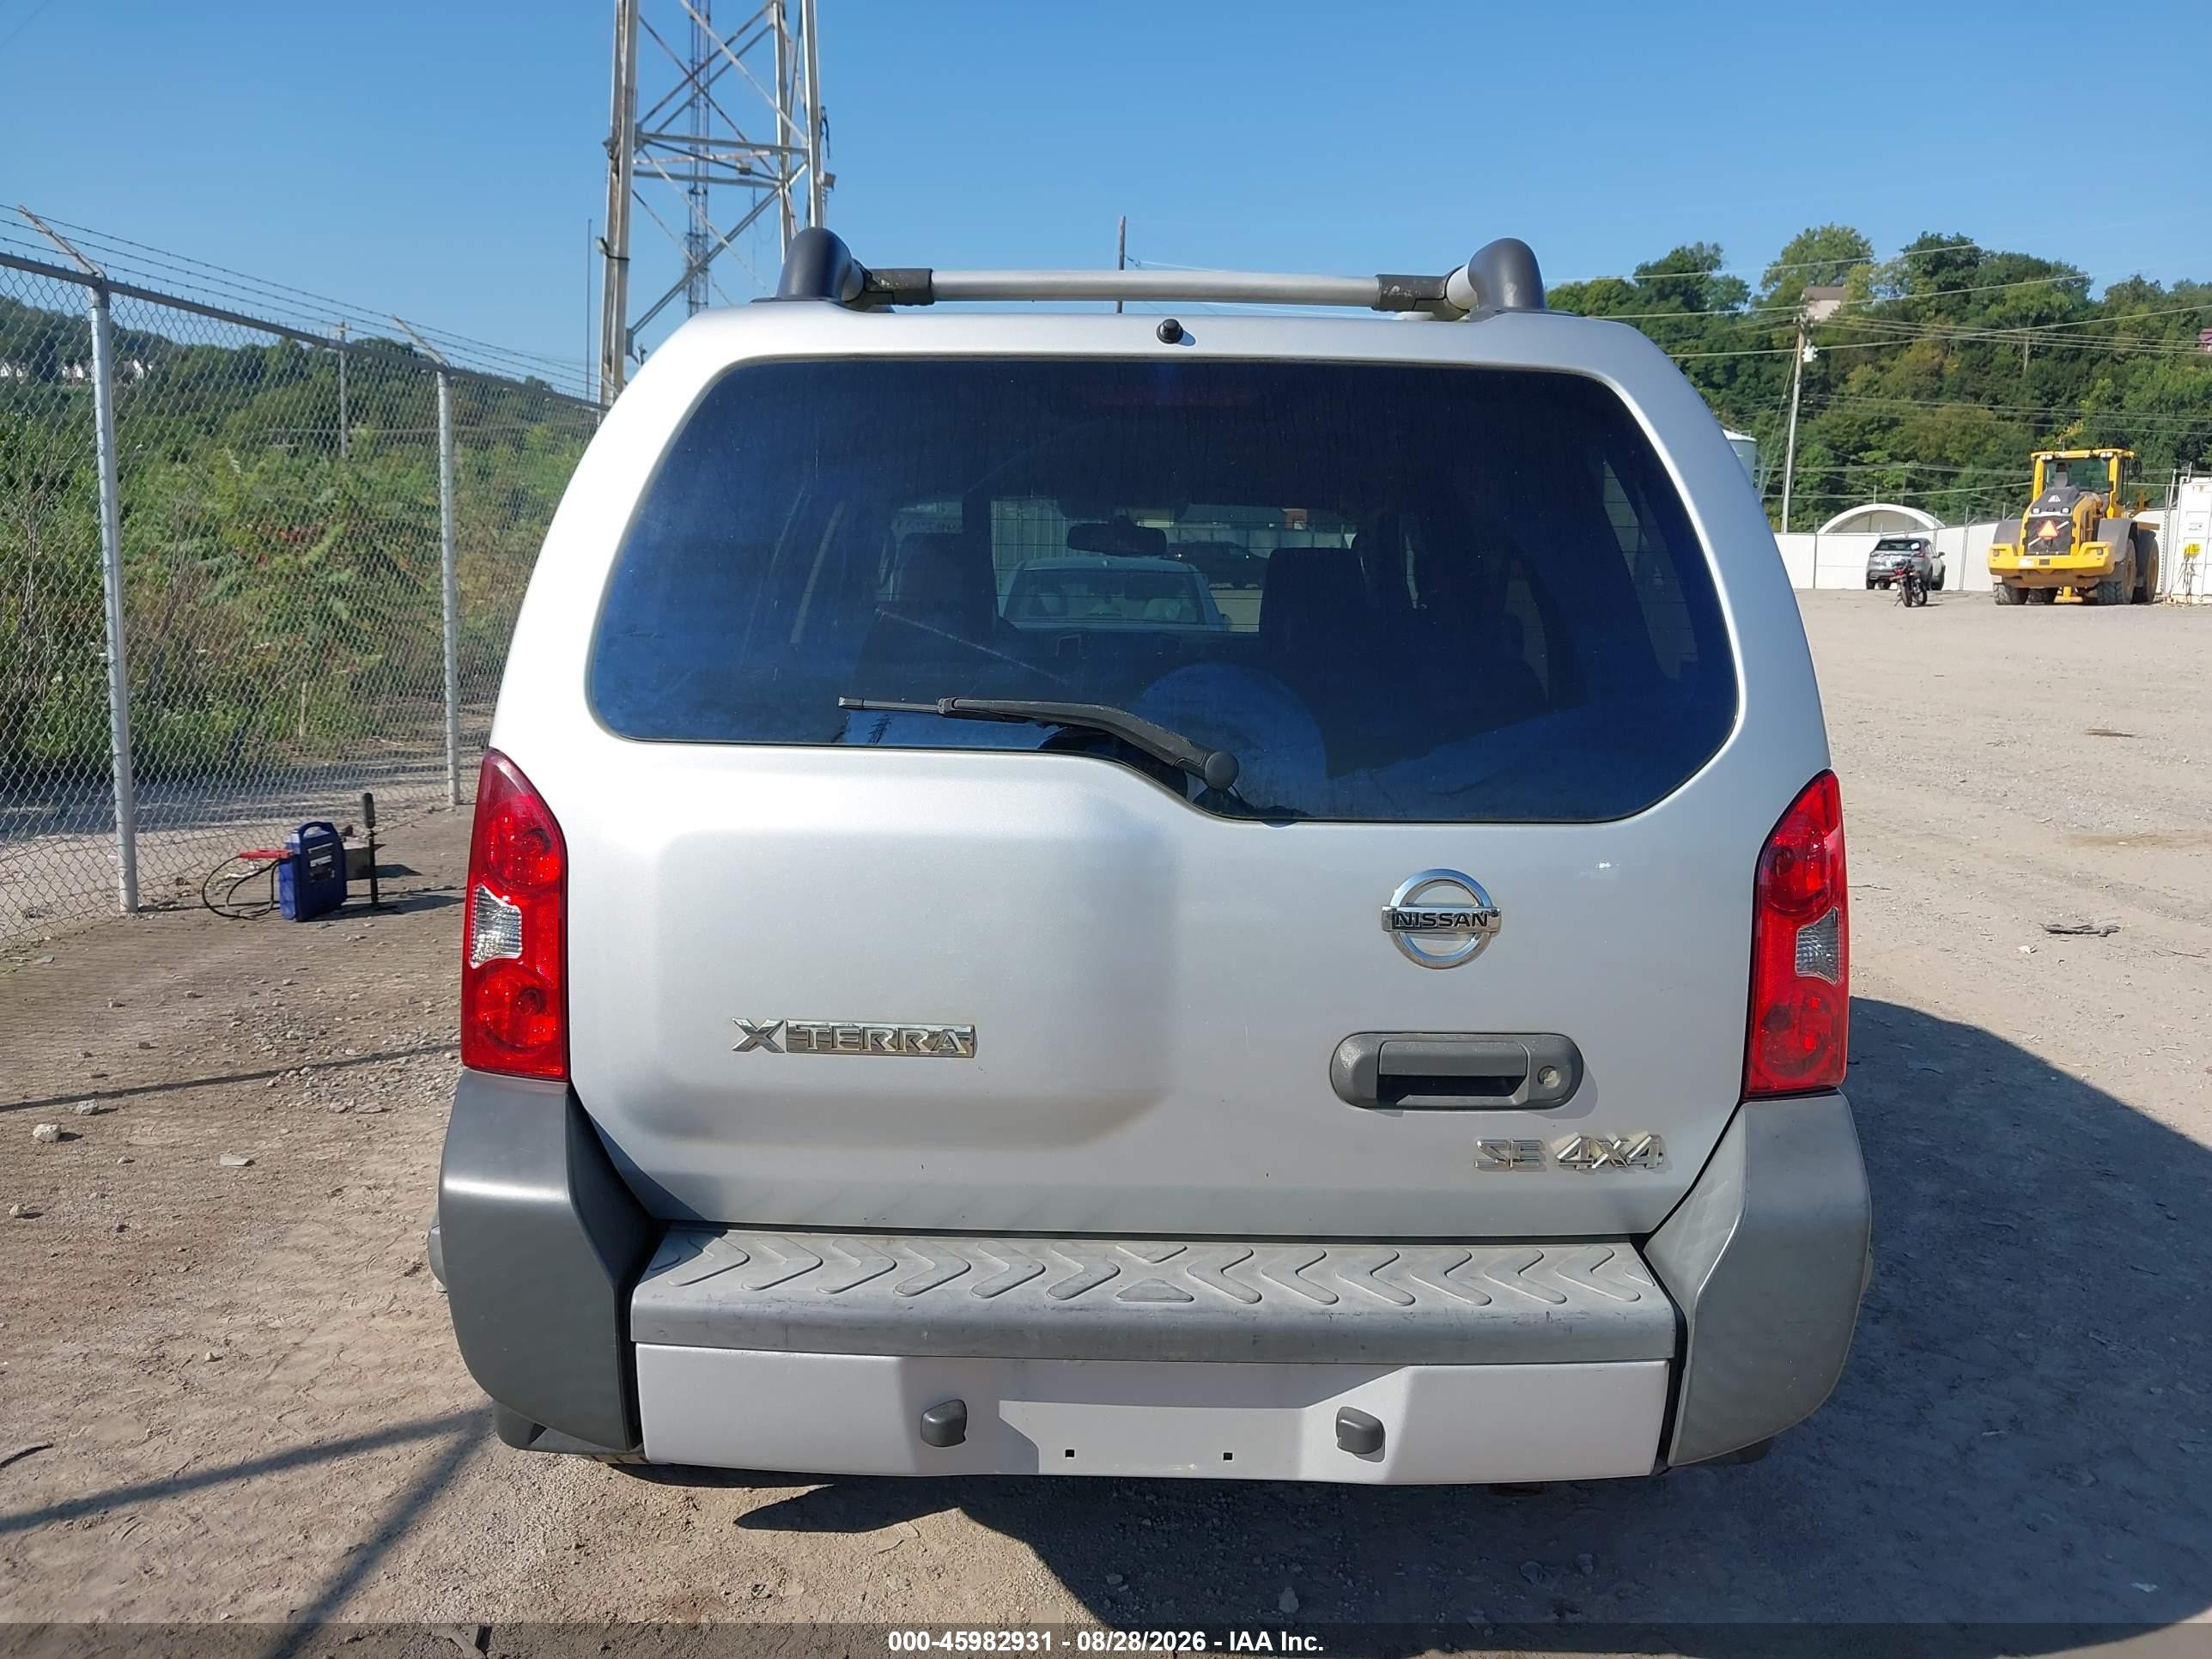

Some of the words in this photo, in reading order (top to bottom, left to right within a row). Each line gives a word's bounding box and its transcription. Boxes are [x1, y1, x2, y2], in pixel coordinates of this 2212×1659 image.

[1395, 912, 1488, 927] NISSAN
[731, 1018, 971, 1055] XTERRA
[1474, 1139, 1541, 1169] SE
[1556, 1133, 1664, 1170] 4X4
